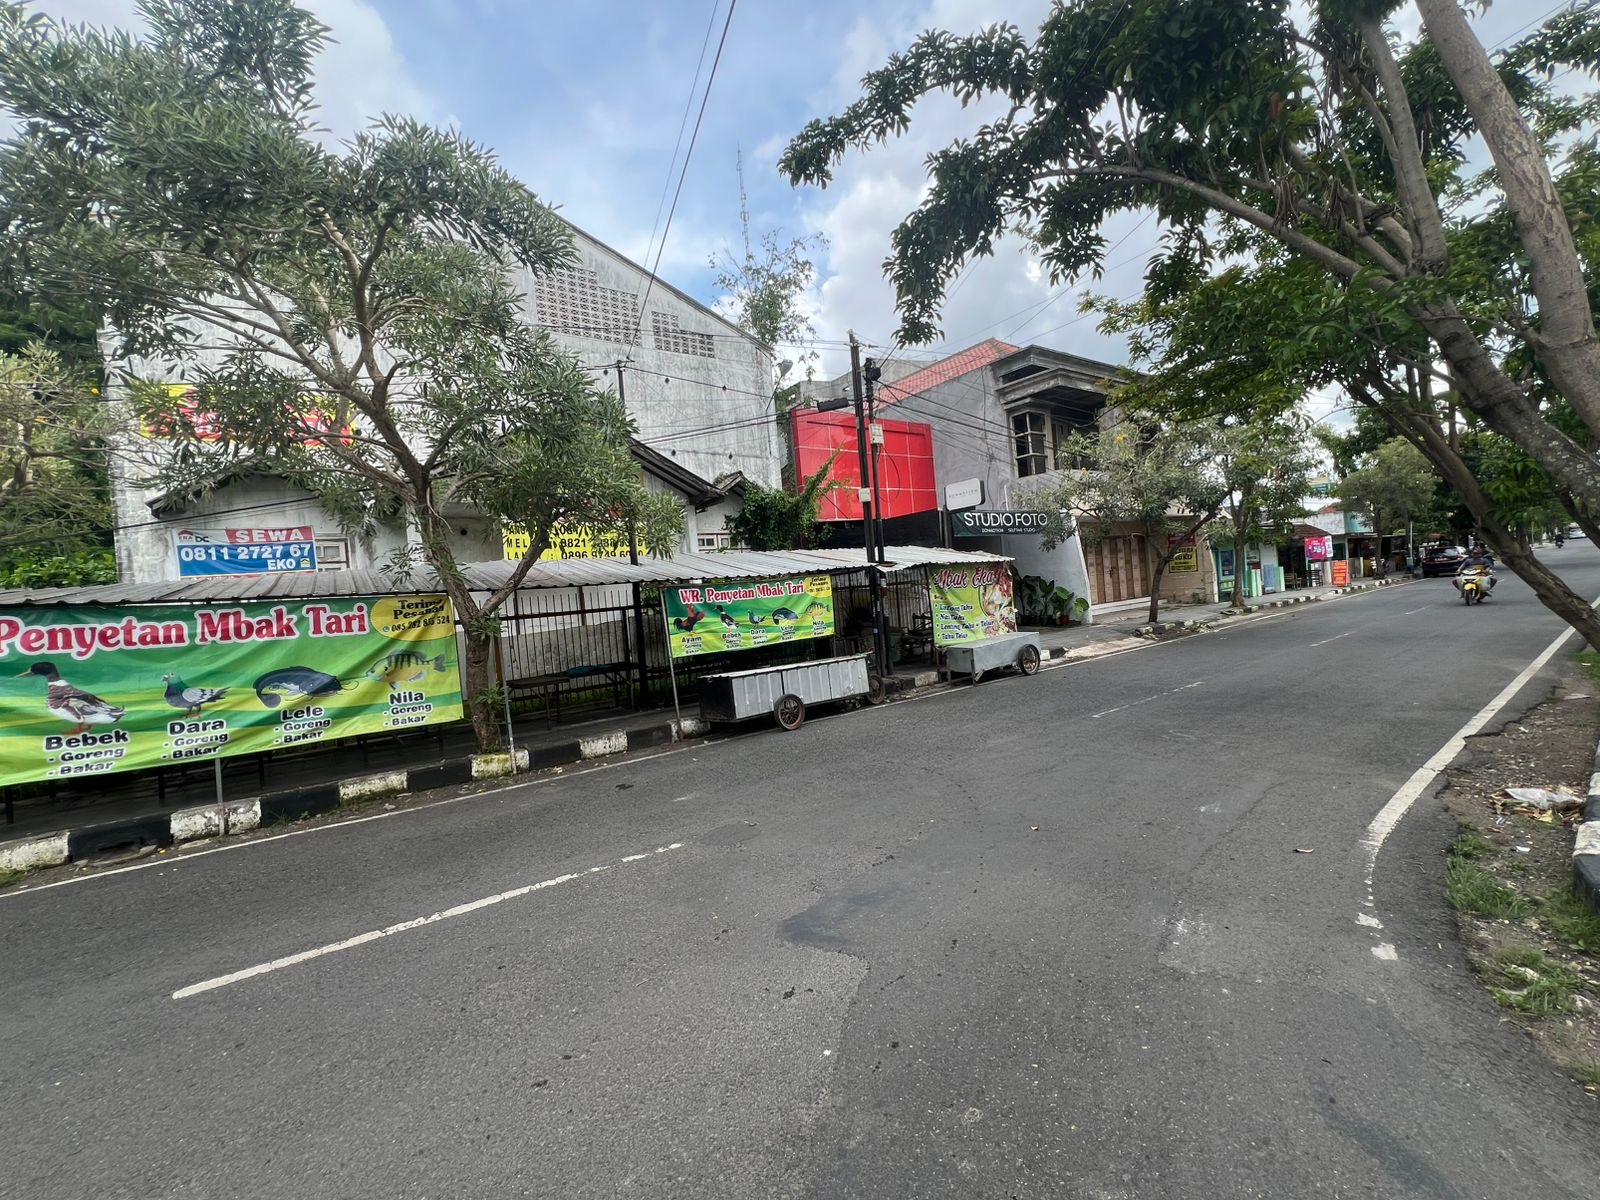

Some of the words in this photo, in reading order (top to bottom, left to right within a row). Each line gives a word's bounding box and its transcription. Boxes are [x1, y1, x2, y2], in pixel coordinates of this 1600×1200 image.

[964, 512, 1013, 526] STUDIO
[1014, 512, 1048, 526] FOTO
[235, 529, 304, 543] SEWA
[506, 537, 528, 548] MEL
[180, 547, 229, 562] 0811
[237, 545, 283, 560] 2727
[289, 544, 310, 557] 67
[267, 559, 296, 570] EKO
[680, 589, 704, 602] WR.
[706, 588, 755, 602] Penyetan
[757, 584, 784, 597] Mbak
[786, 581, 804, 594] Tari
[0, 617, 188, 659] Penyetan
[197, 607, 297, 643] Mbak
[305, 604, 368, 636] Tari
[390, 690, 424, 704] Nila
[281, 705, 324, 721] Lele
[391, 703, 432, 715] Goreng
[169, 719, 225, 735] Dara
[283, 718, 331, 731] Goreng
[392, 714, 426, 726] Bakar
[45, 729, 129, 750] Bebek
[174, 733, 228, 747] Goreng
[283, 730, 323, 743] Bakar
[60, 747, 125, 762] Goreng
[172, 745, 219, 759] Bakar
[60, 761, 113, 775] Bakar
